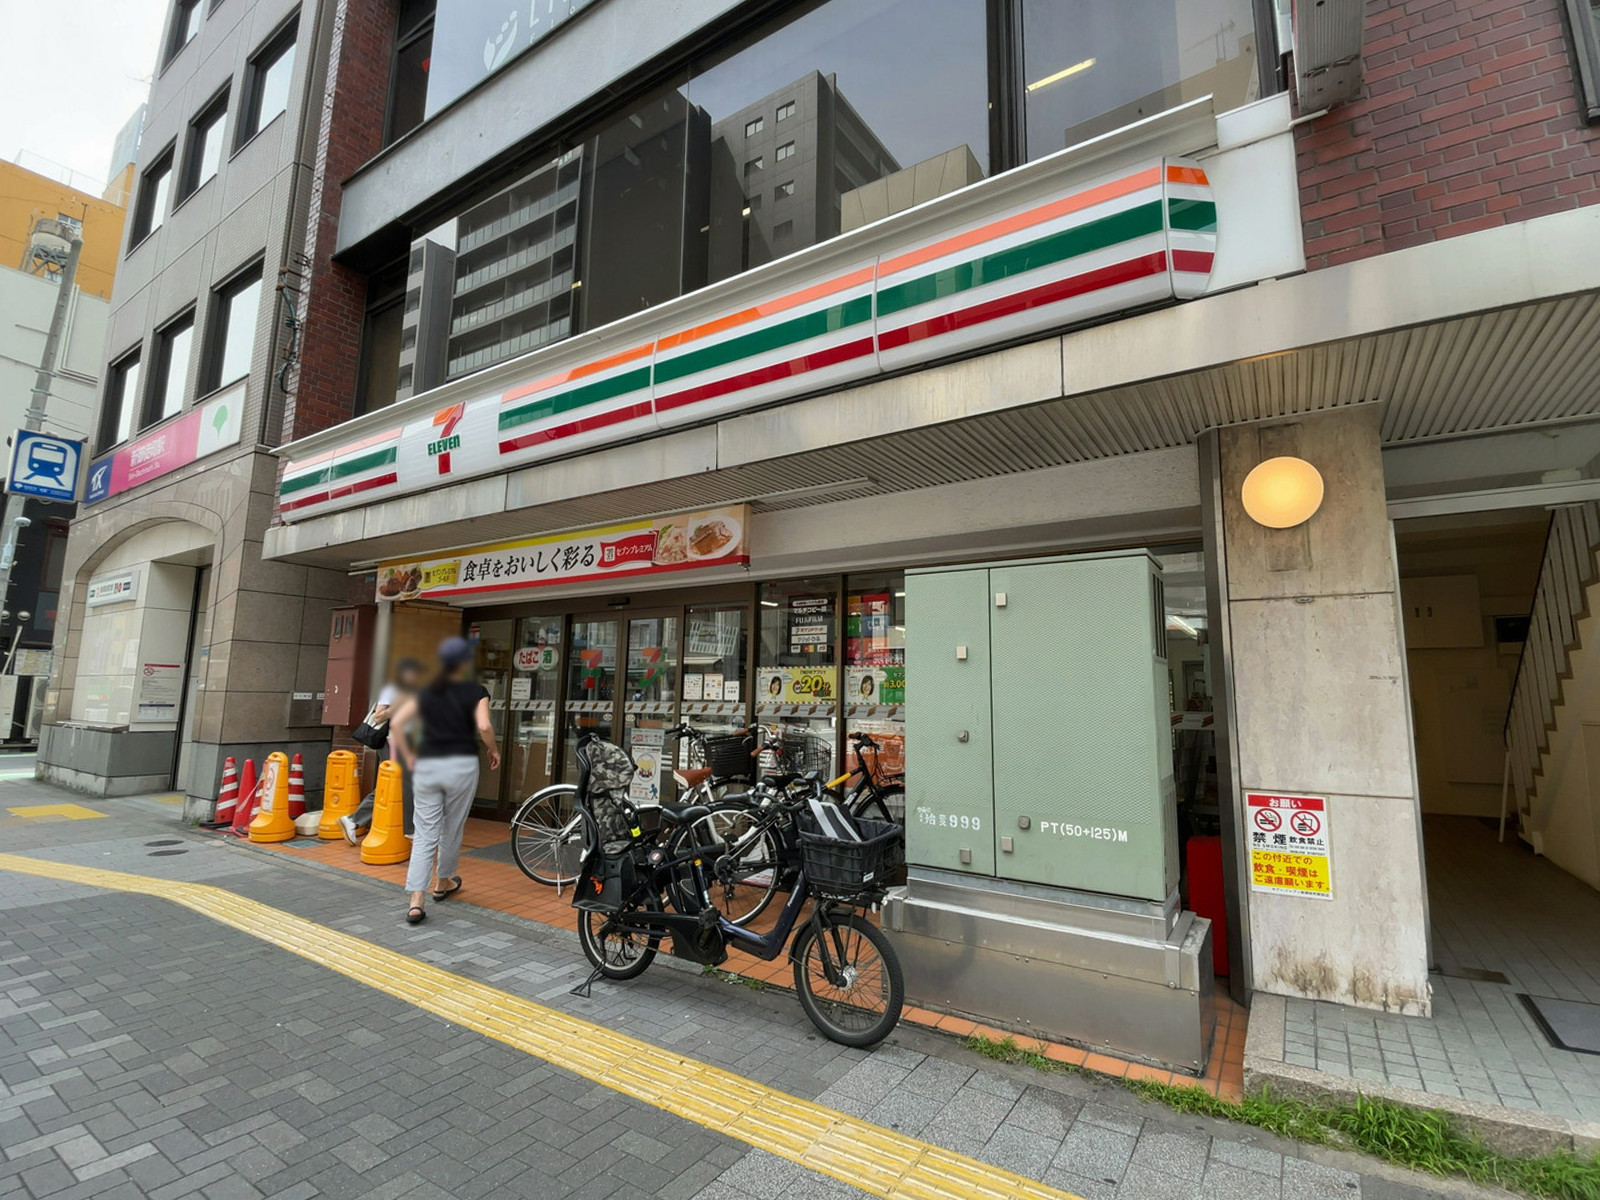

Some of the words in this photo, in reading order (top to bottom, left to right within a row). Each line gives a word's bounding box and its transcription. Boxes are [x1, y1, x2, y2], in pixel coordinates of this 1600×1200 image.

[463, 544, 595, 583] 食卓をおいしく彩る
[518, 650, 540, 665] たばこ
[542, 649, 553, 664] 酒
[1268, 797, 1302, 809] お願い
[1040, 821, 1128, 843] PT(50+125)M
[1289, 836, 1325, 847] 飲食禁止
[1253, 851, 1314, 866] この付近での
[1253, 862, 1319, 878] 飲食・喫煙は
